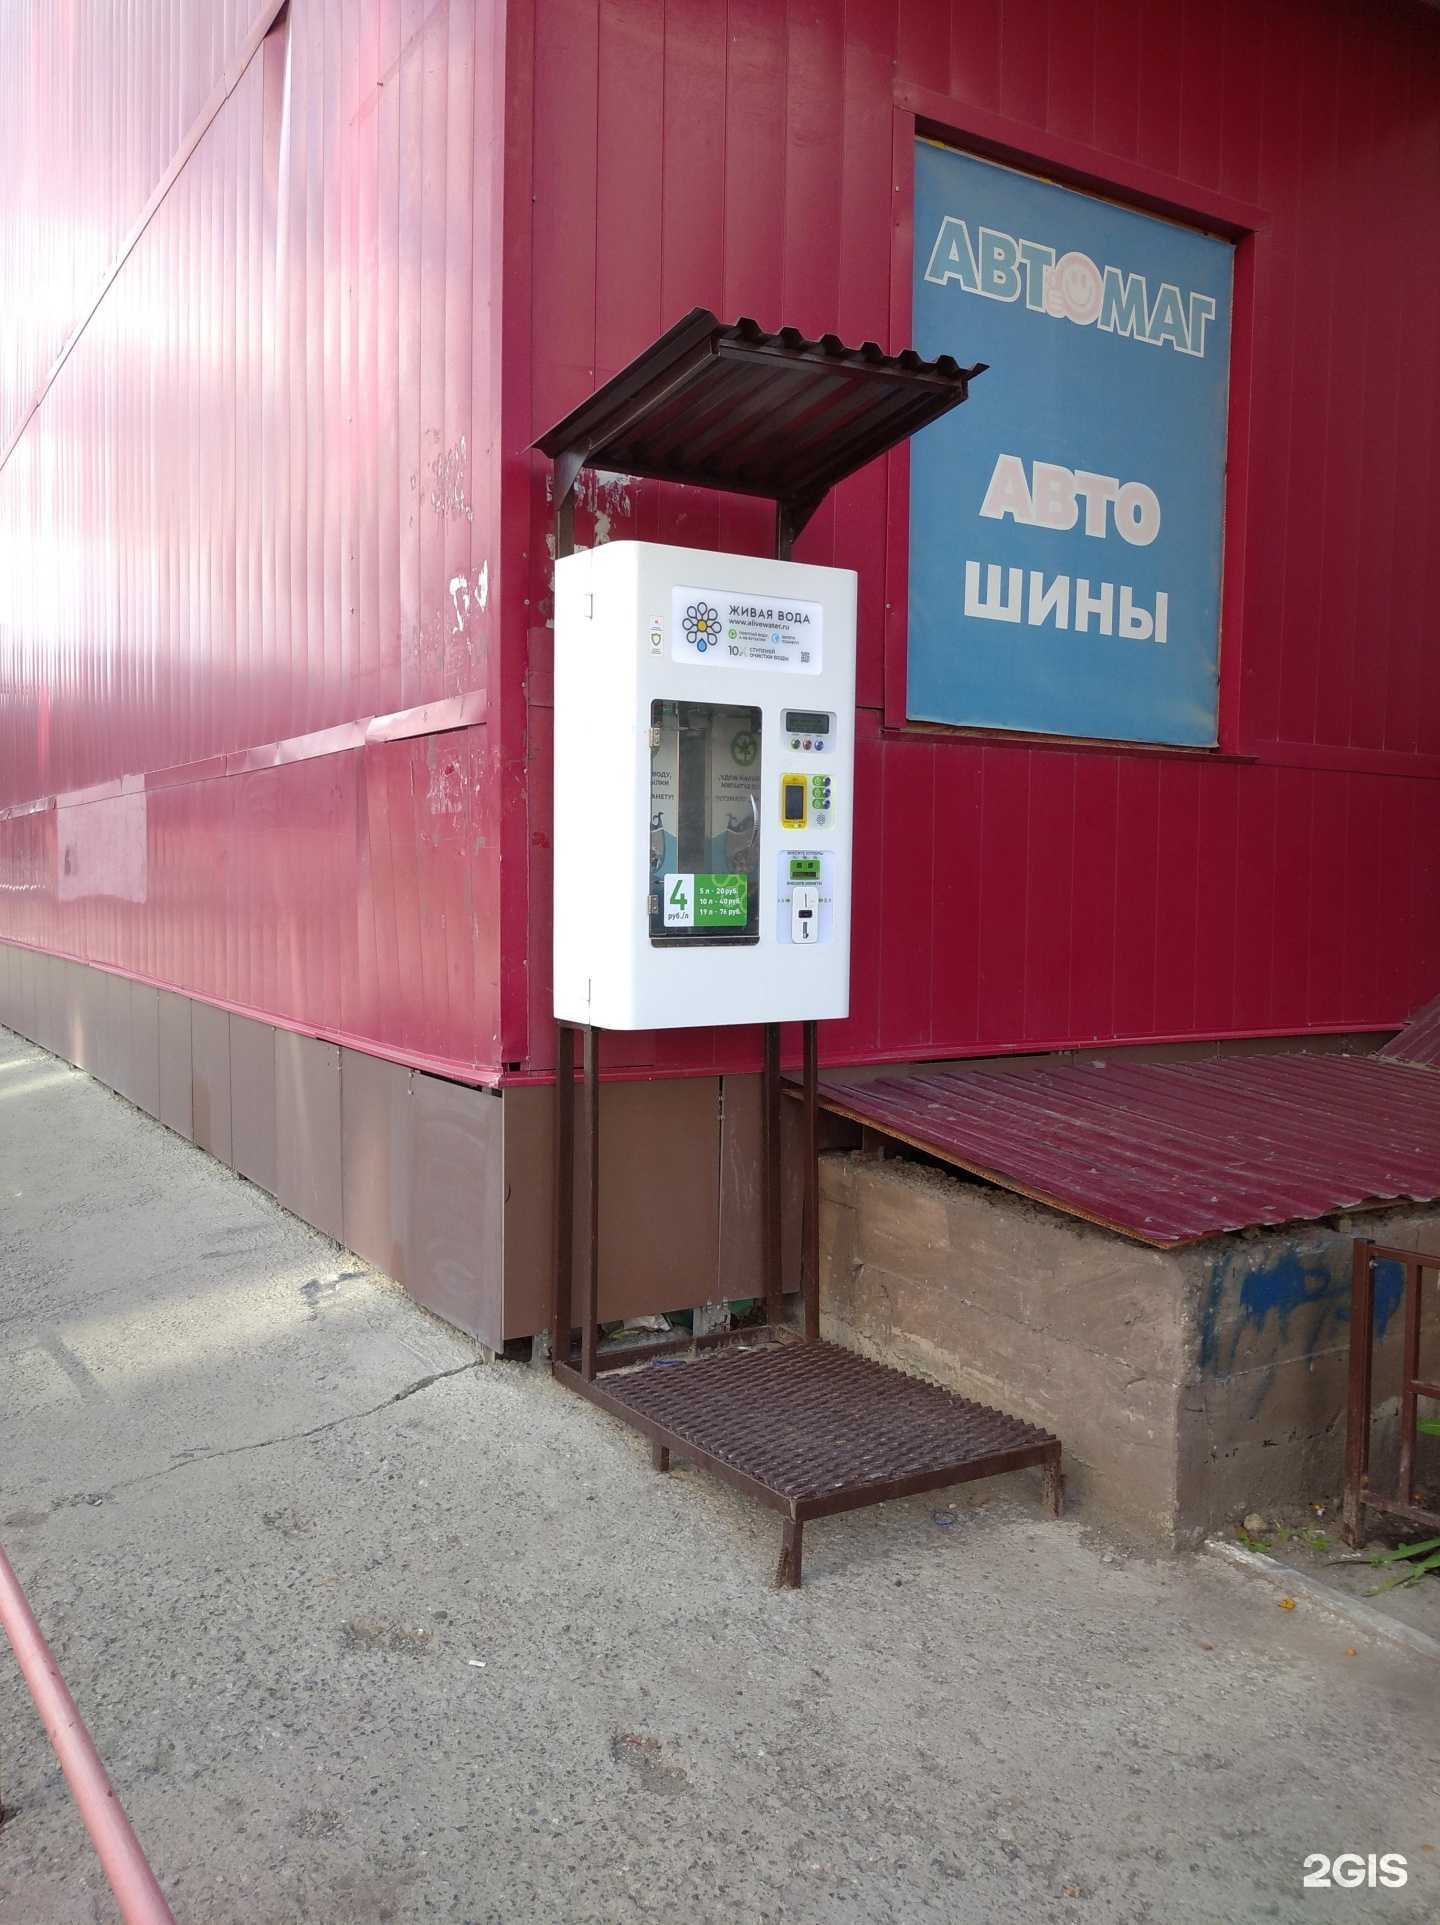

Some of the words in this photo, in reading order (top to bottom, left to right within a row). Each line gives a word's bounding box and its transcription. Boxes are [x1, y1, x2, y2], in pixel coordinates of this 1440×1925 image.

[924, 215, 1215, 357] АВТОМАГ
[979, 453, 1161, 547] АВТО
[963, 560, 1168, 643] ШИНЫ
[729, 605, 773, 620] ЖИВАЯ
[778, 610, 811, 624] ВОДА
[729, 619, 790, 631] www.alivewater.ru
[728, 645, 739, 656] 10
[670, 880, 687, 910] 4
[699, 887, 704, 895] 5
[716, 887, 725, 895] 20
[668, 912, 689, 921] руб./л
